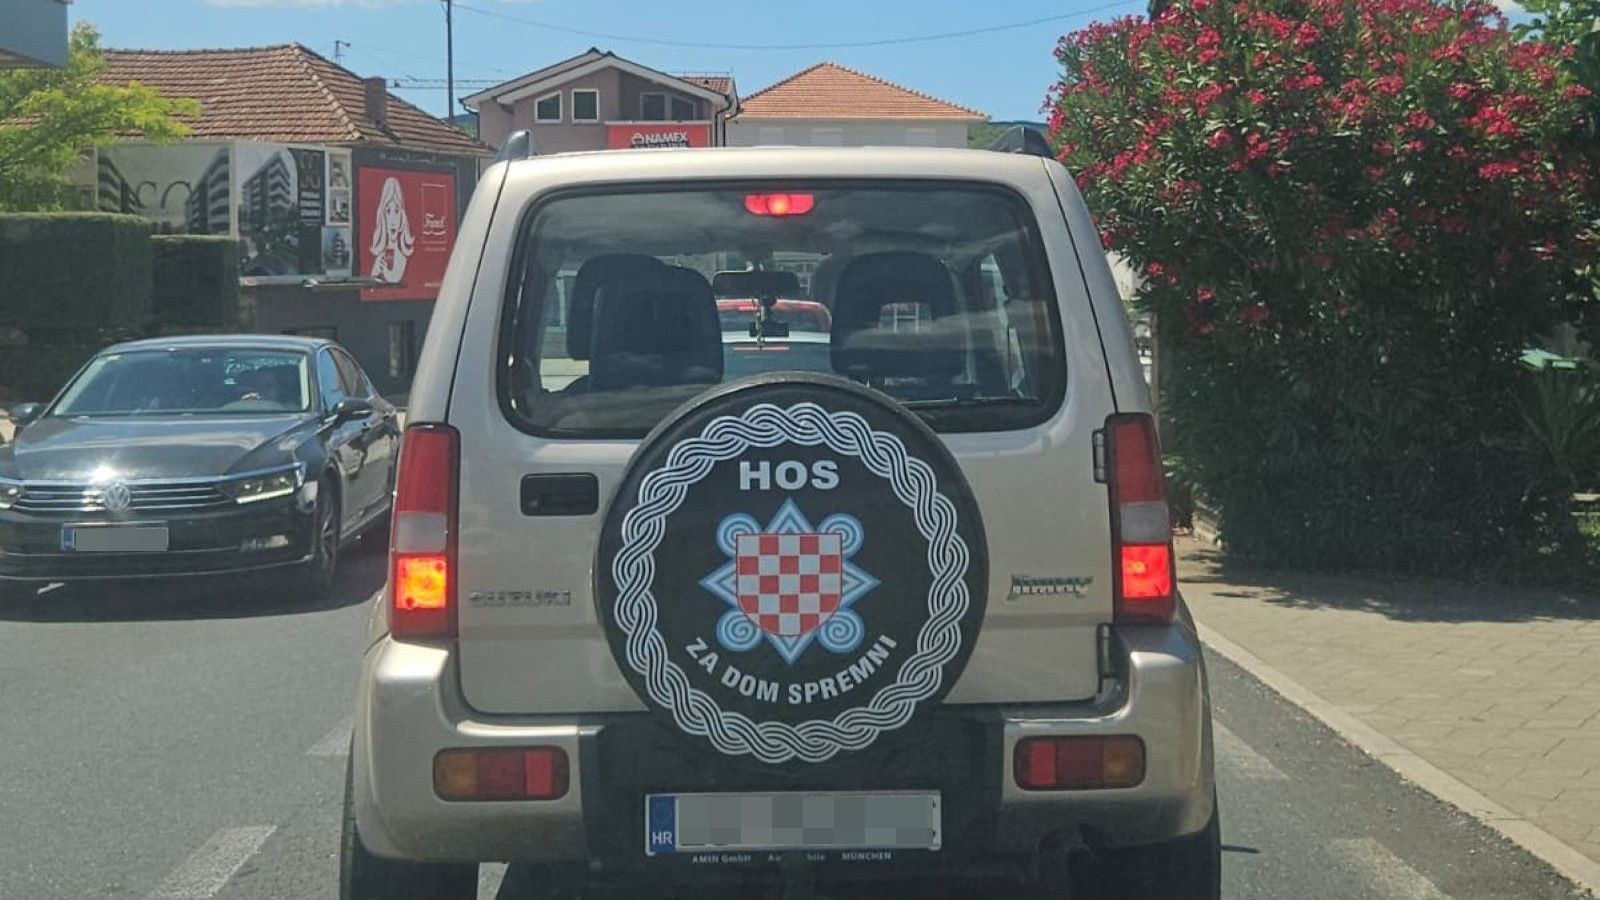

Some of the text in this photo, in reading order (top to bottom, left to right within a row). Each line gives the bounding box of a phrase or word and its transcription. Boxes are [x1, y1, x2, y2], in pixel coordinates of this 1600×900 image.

[645, 132, 688, 145] NAMEX
[739, 459, 840, 491] HOS
[685, 633, 898, 705] ZA DOM SPREMNI
[652, 831, 673, 845] HR
